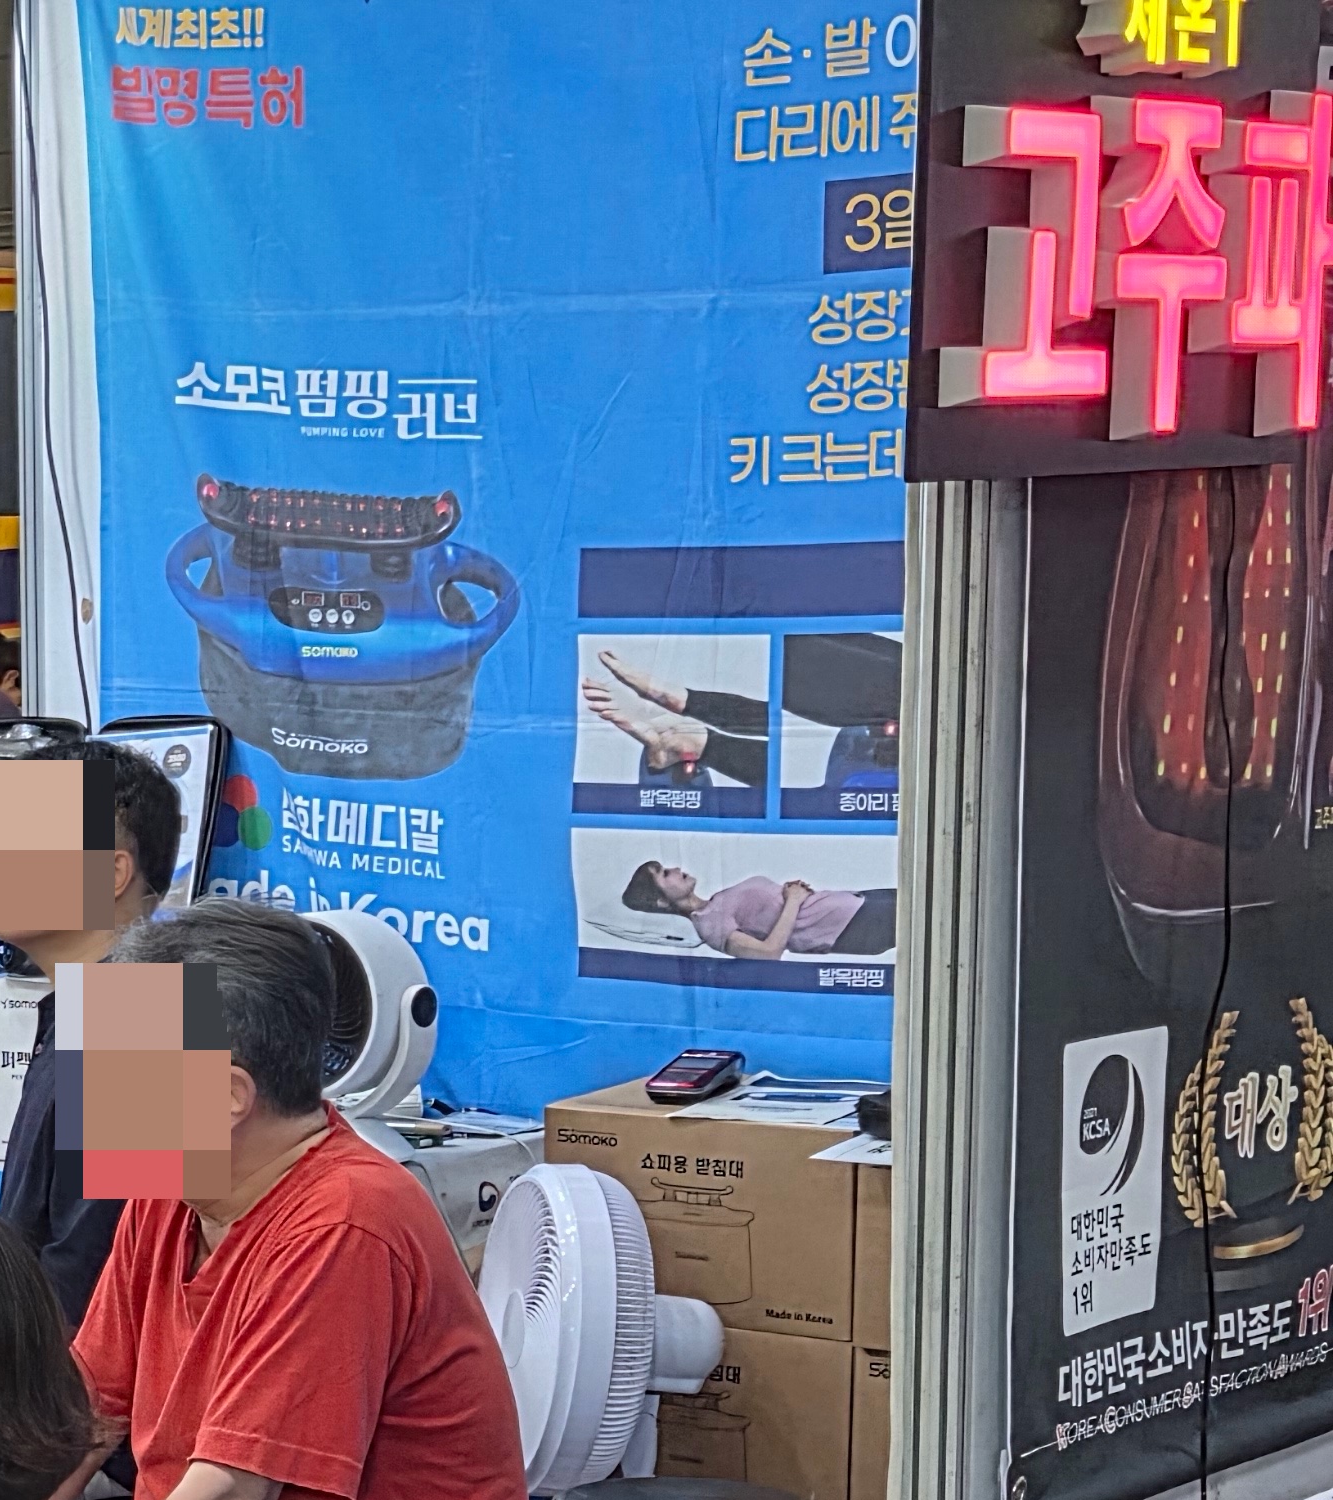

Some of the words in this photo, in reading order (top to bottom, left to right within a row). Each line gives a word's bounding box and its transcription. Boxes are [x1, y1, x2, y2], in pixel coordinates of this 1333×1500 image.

[734, 94, 881, 162] 다리에
[984, 92, 1333, 434] 고주파
[808, 288, 911, 345] 성장
[352, 427, 386, 439] LOVE
[729, 434, 771, 486] 키
[839, 791, 888, 813] 종아리
[352, 852, 446, 880] MEDICAL
[208, 869, 296, 909] ade
[340, 890, 491, 952] Korea
[1082, 1117, 1111, 1141] KCSA
[1223, 1065, 1299, 1159] 대상
[695, 1157, 745, 1179] 받침대
[1070, 1203, 1125, 1242] 대한민국
[1070, 1232, 1152, 1277] 소비자만족도
[765, 1308, 792, 1320] Made
[794, 1312, 803, 1321] in
[805, 1312, 834, 1325] Korea
[1072, 1280, 1093, 1316] 1위
